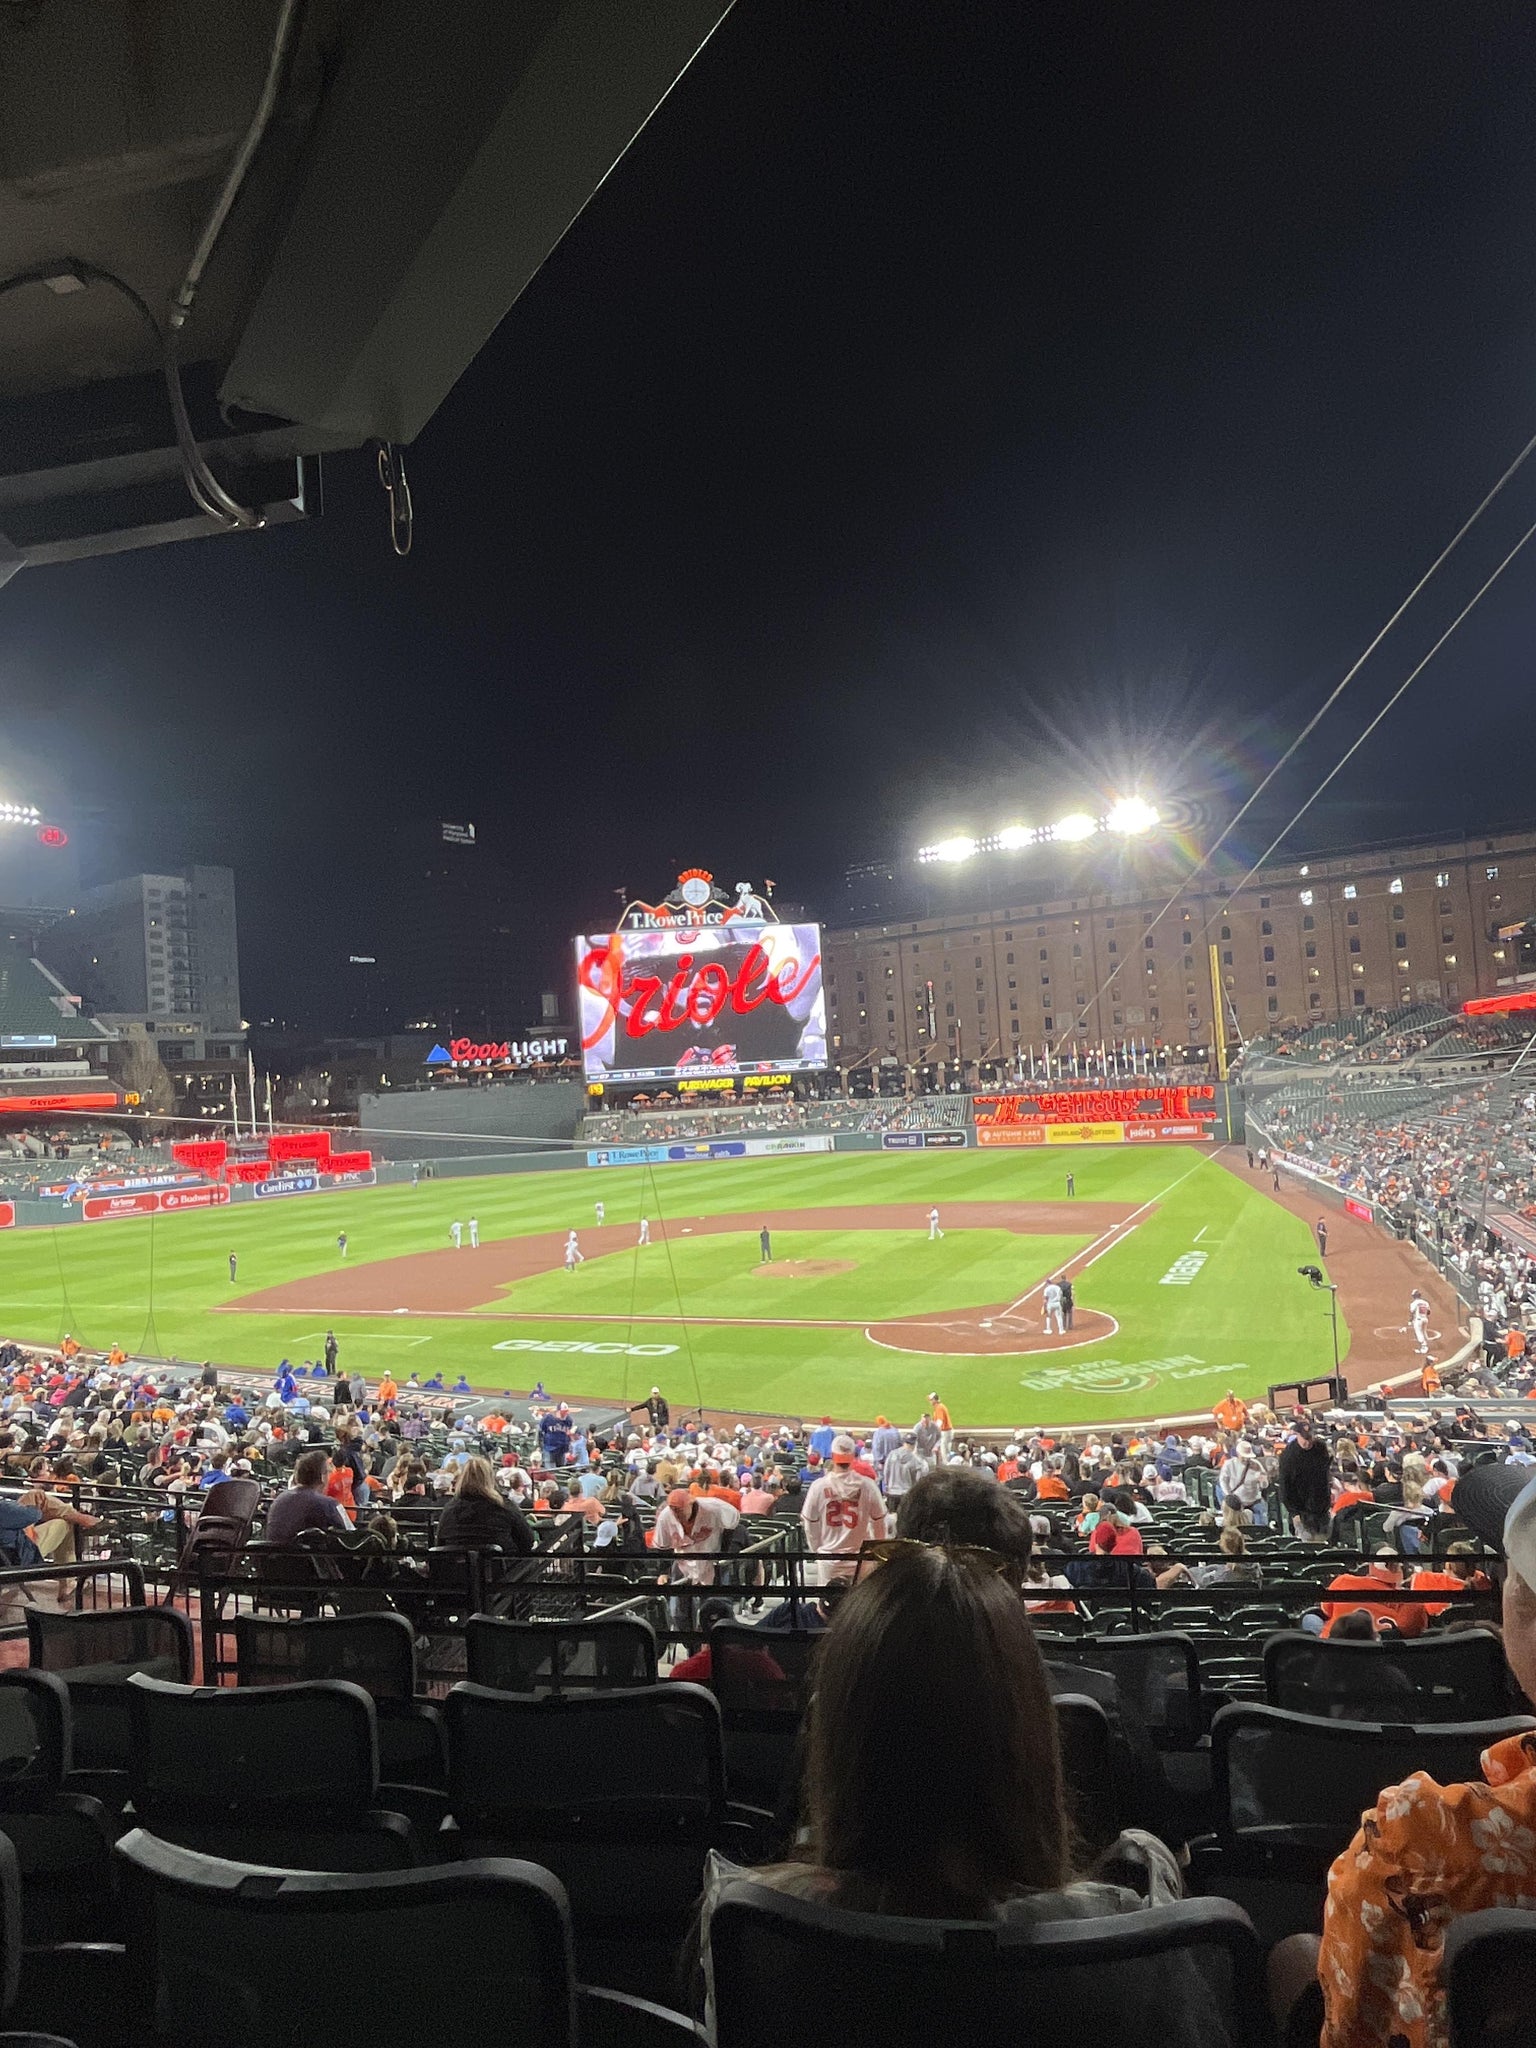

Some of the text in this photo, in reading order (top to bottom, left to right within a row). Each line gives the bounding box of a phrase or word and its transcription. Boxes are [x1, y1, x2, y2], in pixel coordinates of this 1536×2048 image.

[451, 1037, 567, 1060] Coors LIGHT
[451, 1055, 545, 1068] ROOF DECK
[743, 1075, 792, 1086] PAVILION
[124, 1175, 176, 1187] BIRD BATH
[343, 1173, 361, 1181] PNC
[261, 1180, 296, 1193] CareFirst
[491, 1339, 681, 1356] GEICO
[1019, 1364, 1154, 1391] OPENING
[826, 1500, 859, 1529] 25
